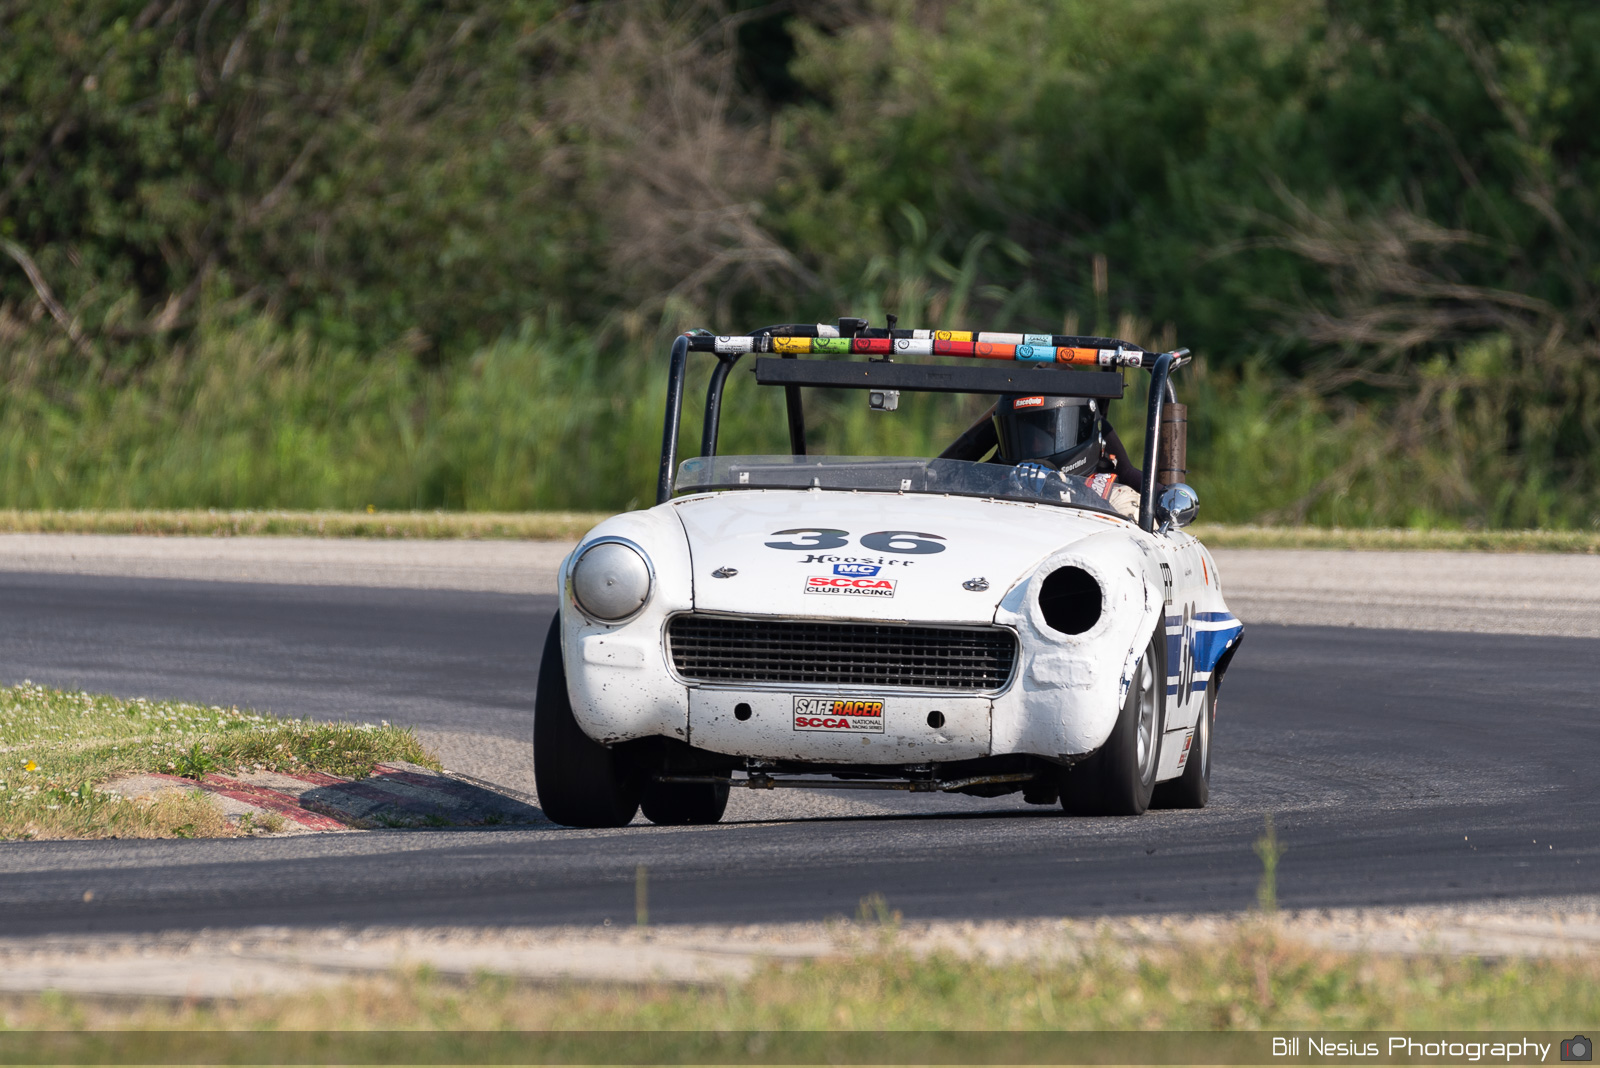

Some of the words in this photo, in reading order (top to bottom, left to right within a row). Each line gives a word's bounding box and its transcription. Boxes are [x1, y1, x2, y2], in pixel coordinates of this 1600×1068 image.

[1015, 398, 1042, 407] RaceQuip
[764, 528, 947, 555] 36
[797, 554, 914, 566] Hoosier
[808, 577, 893, 589] SCCA
[843, 588, 893, 596] RACING
[1177, 600, 1196, 709] 36
[796, 699, 882, 717] SAFERACER
[795, 717, 851, 729] SCCA
